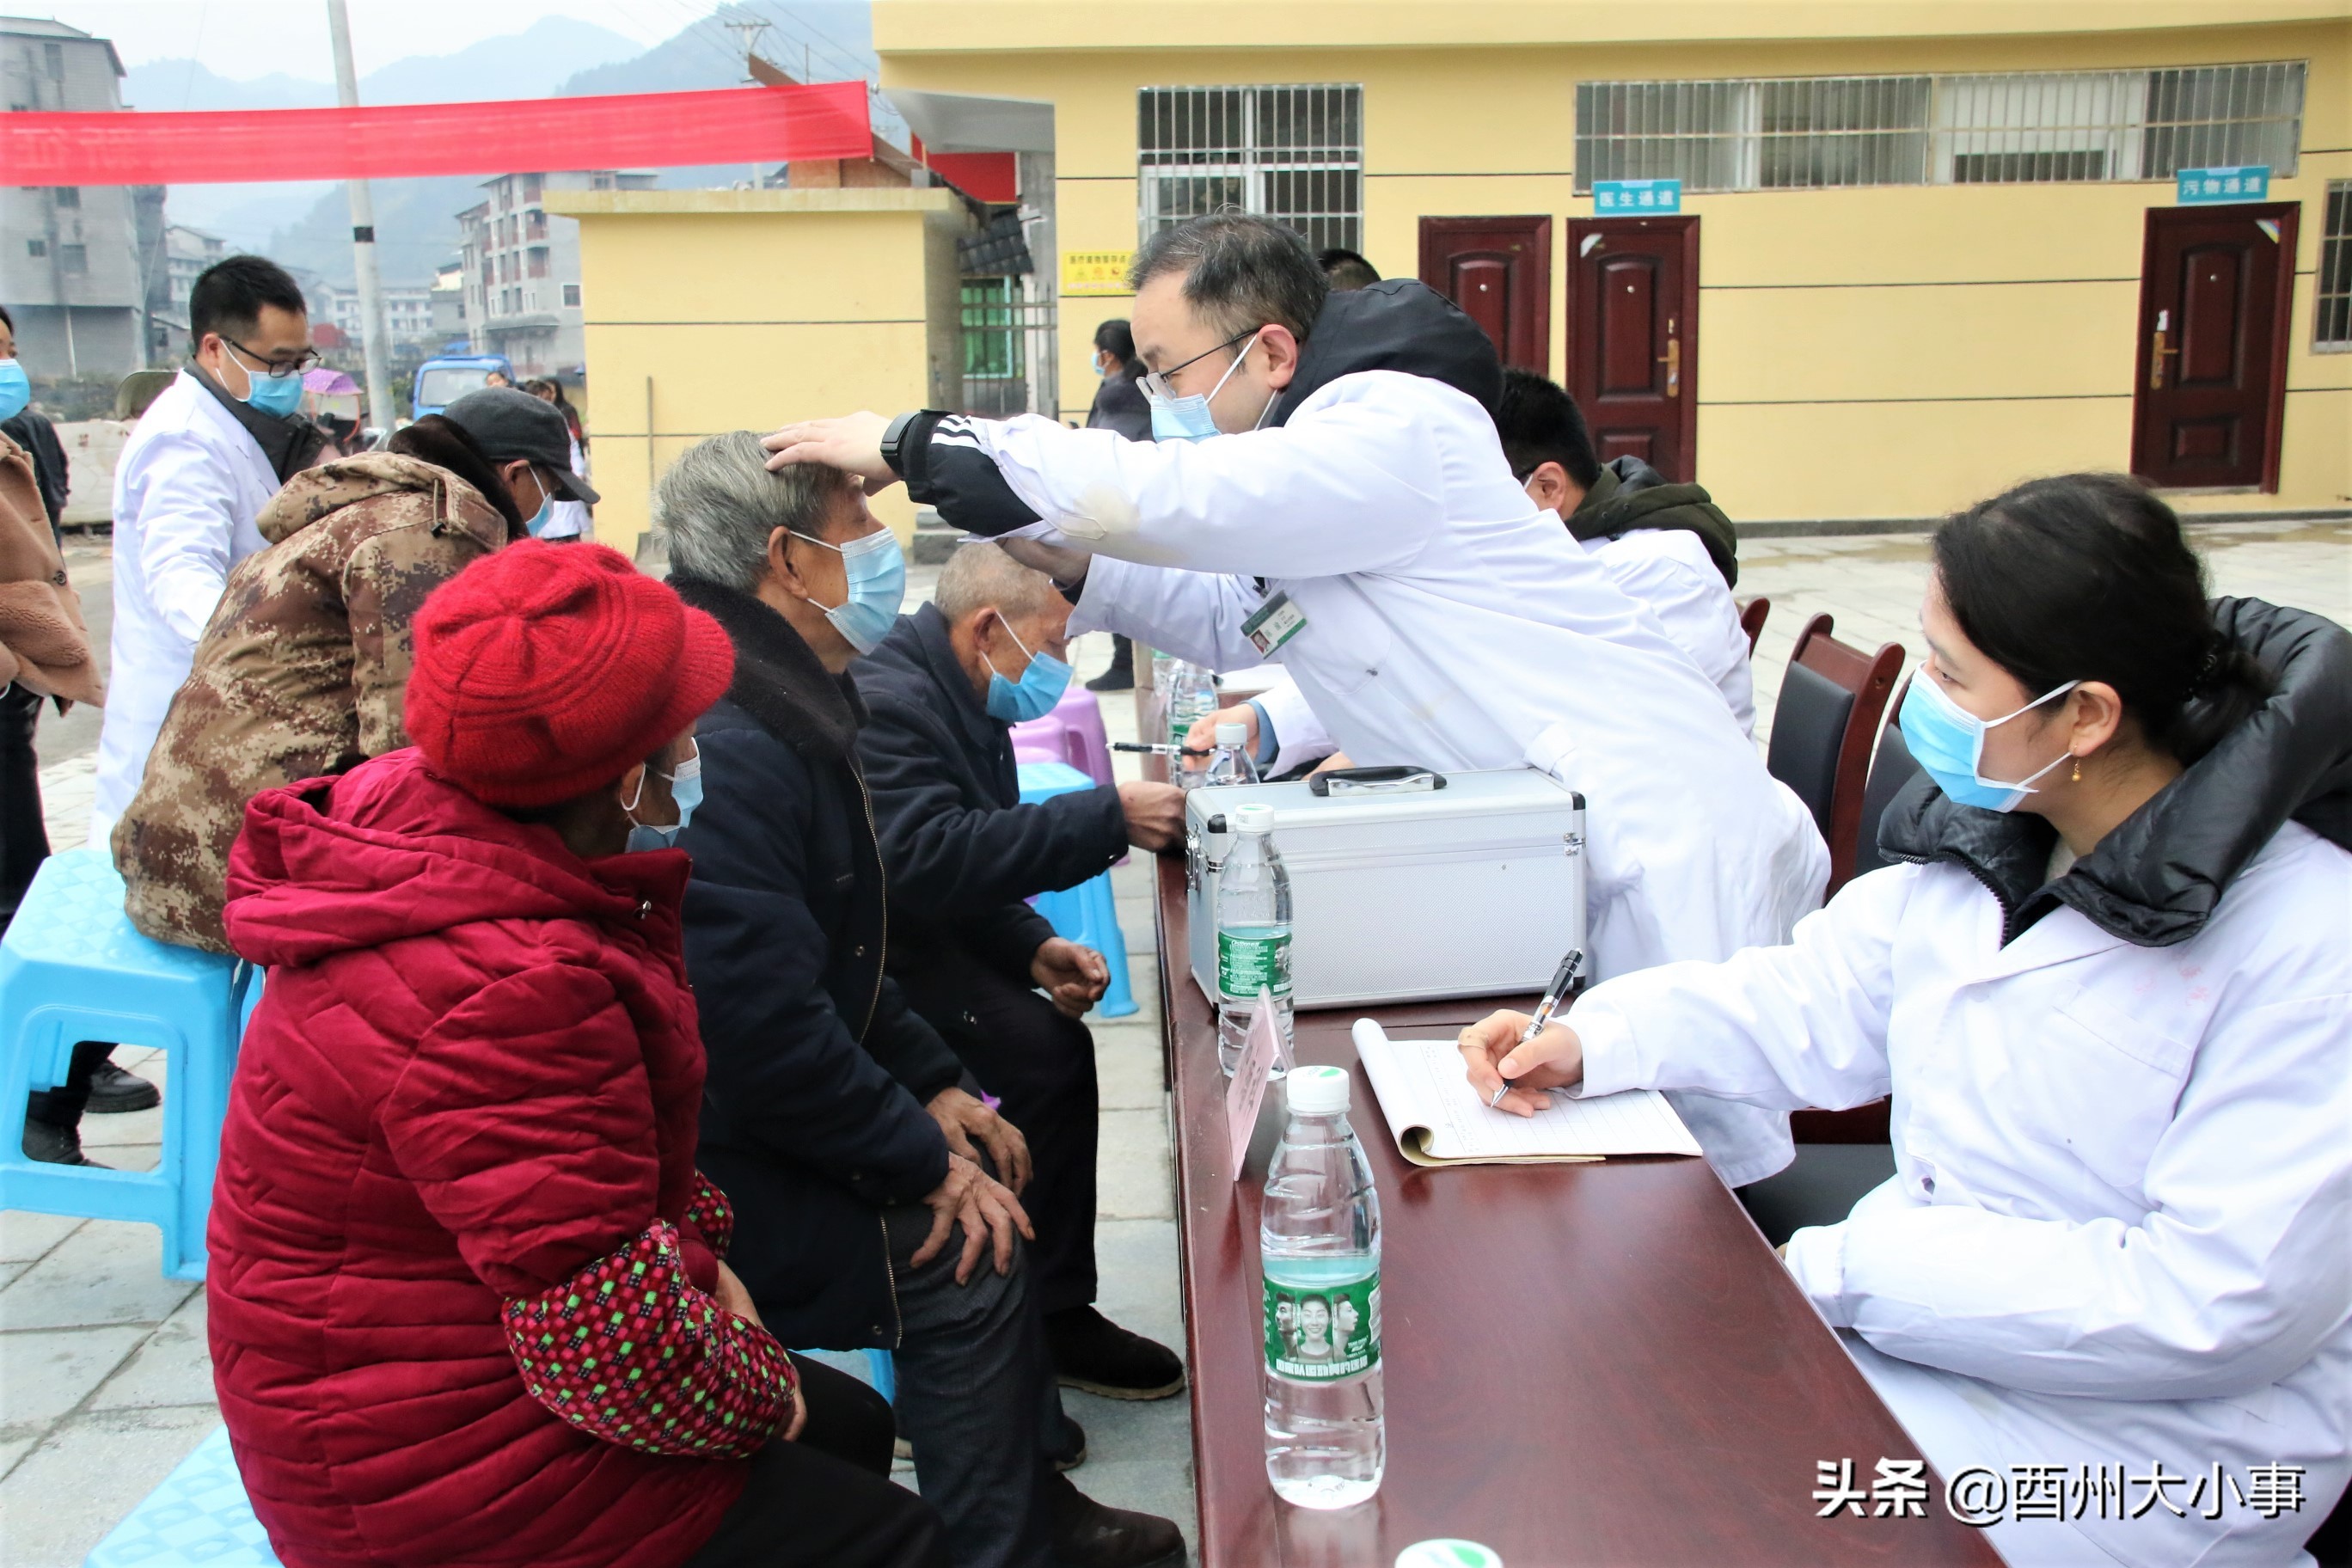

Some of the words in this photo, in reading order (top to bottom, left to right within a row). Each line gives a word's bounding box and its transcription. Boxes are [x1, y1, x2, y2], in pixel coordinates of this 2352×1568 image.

[2182, 177, 2262, 195] 污物通道
[1599, 190, 1675, 207] 医生通道
